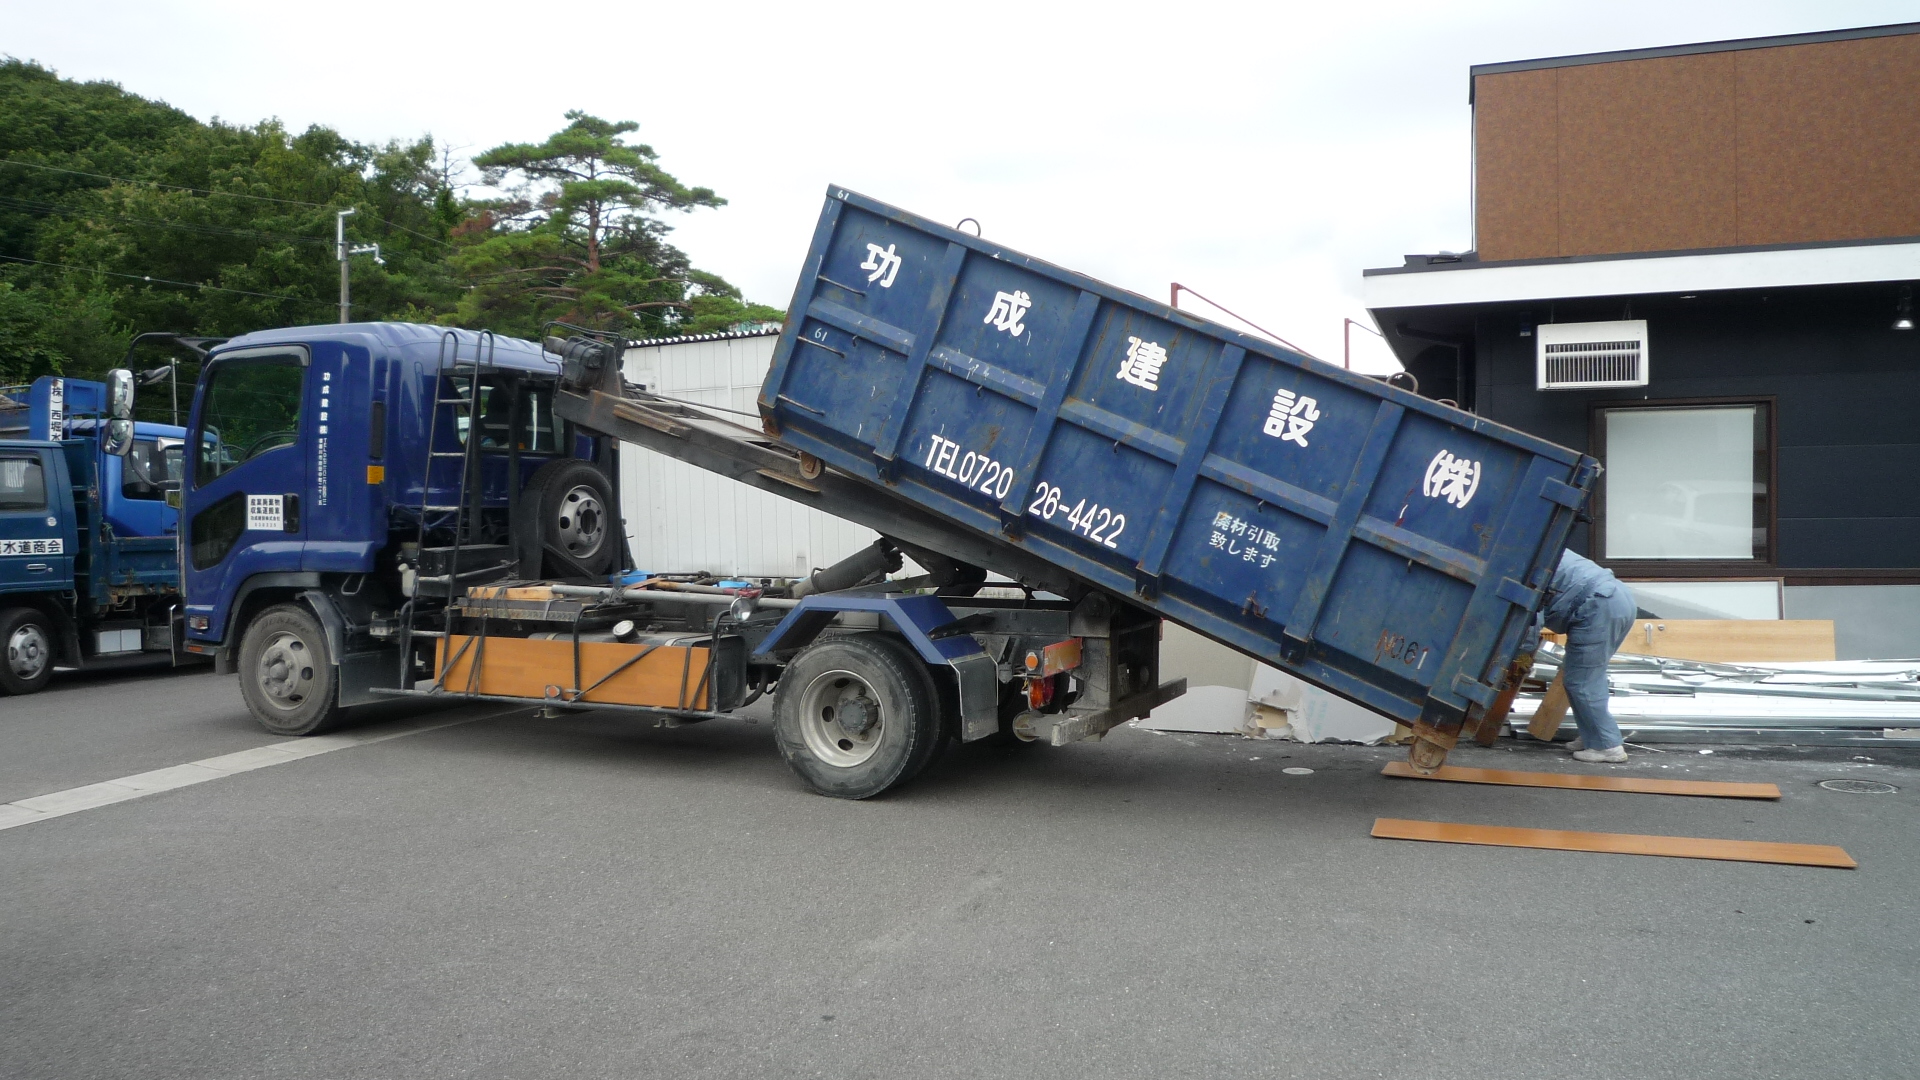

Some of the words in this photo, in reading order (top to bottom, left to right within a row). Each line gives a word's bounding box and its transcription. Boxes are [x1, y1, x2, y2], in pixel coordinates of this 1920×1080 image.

[837, 189, 850, 201] 61
[814, 327, 828, 342] 61
[924, 434, 1014, 500] TEL0720
[1028, 482, 1126, 549] 26-4422
[1212, 511, 1281, 552] 廃材引取
[0, 540, 61, 554] 水道商会
[1209, 530, 1277, 568] 致します
